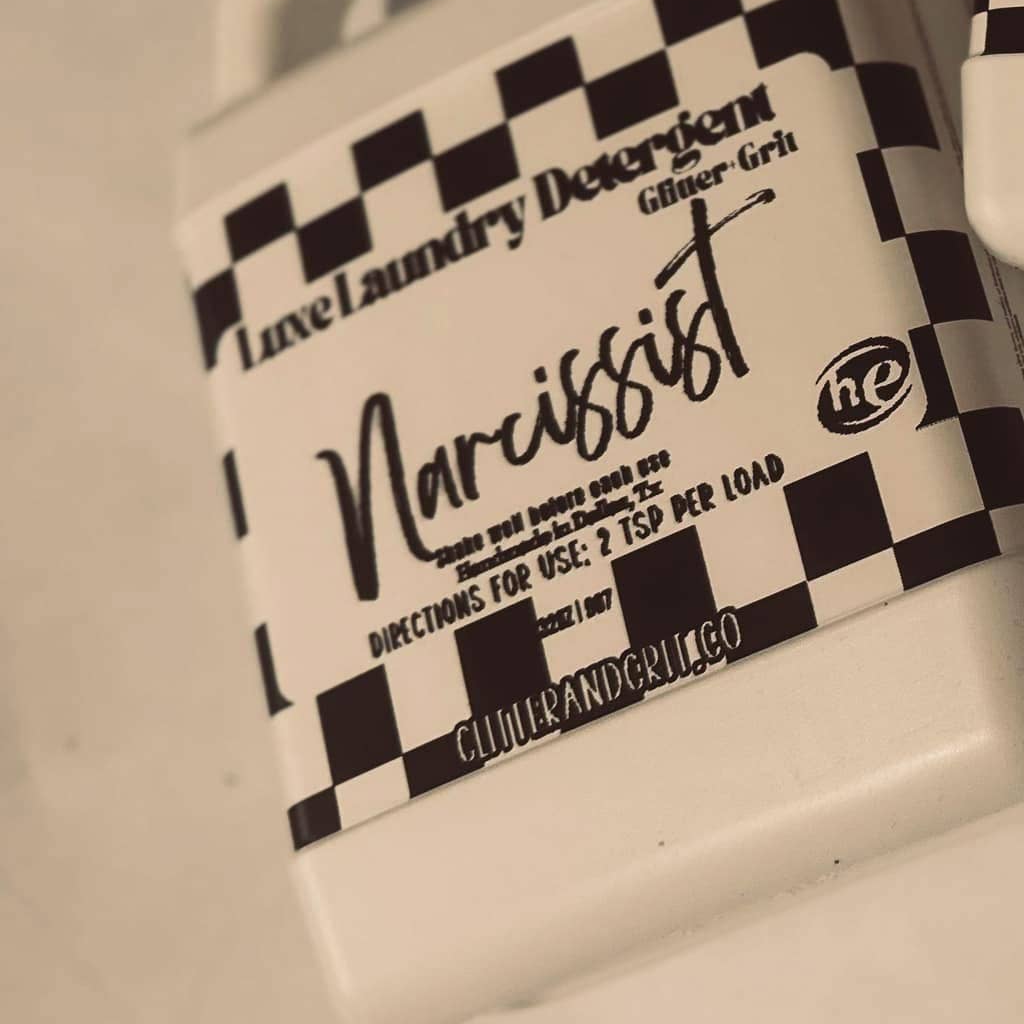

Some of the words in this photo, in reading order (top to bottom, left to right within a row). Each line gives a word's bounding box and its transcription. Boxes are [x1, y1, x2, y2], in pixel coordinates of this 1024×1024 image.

[236, 294, 333, 372] Luxe
[335, 194, 527, 319] Laundry
[533, 83, 776, 221] Detergent
[316, 188, 775, 601] Narcissist
[368, 584, 486, 658] DIRECTIONS
[490, 563, 532, 603] FOR
[538, 539, 591, 580] USE:
[597, 527, 612, 556] 2
[618, 504, 663, 545] TSP
[671, 485, 714, 523] PER
[721, 454, 784, 502] LOAD
